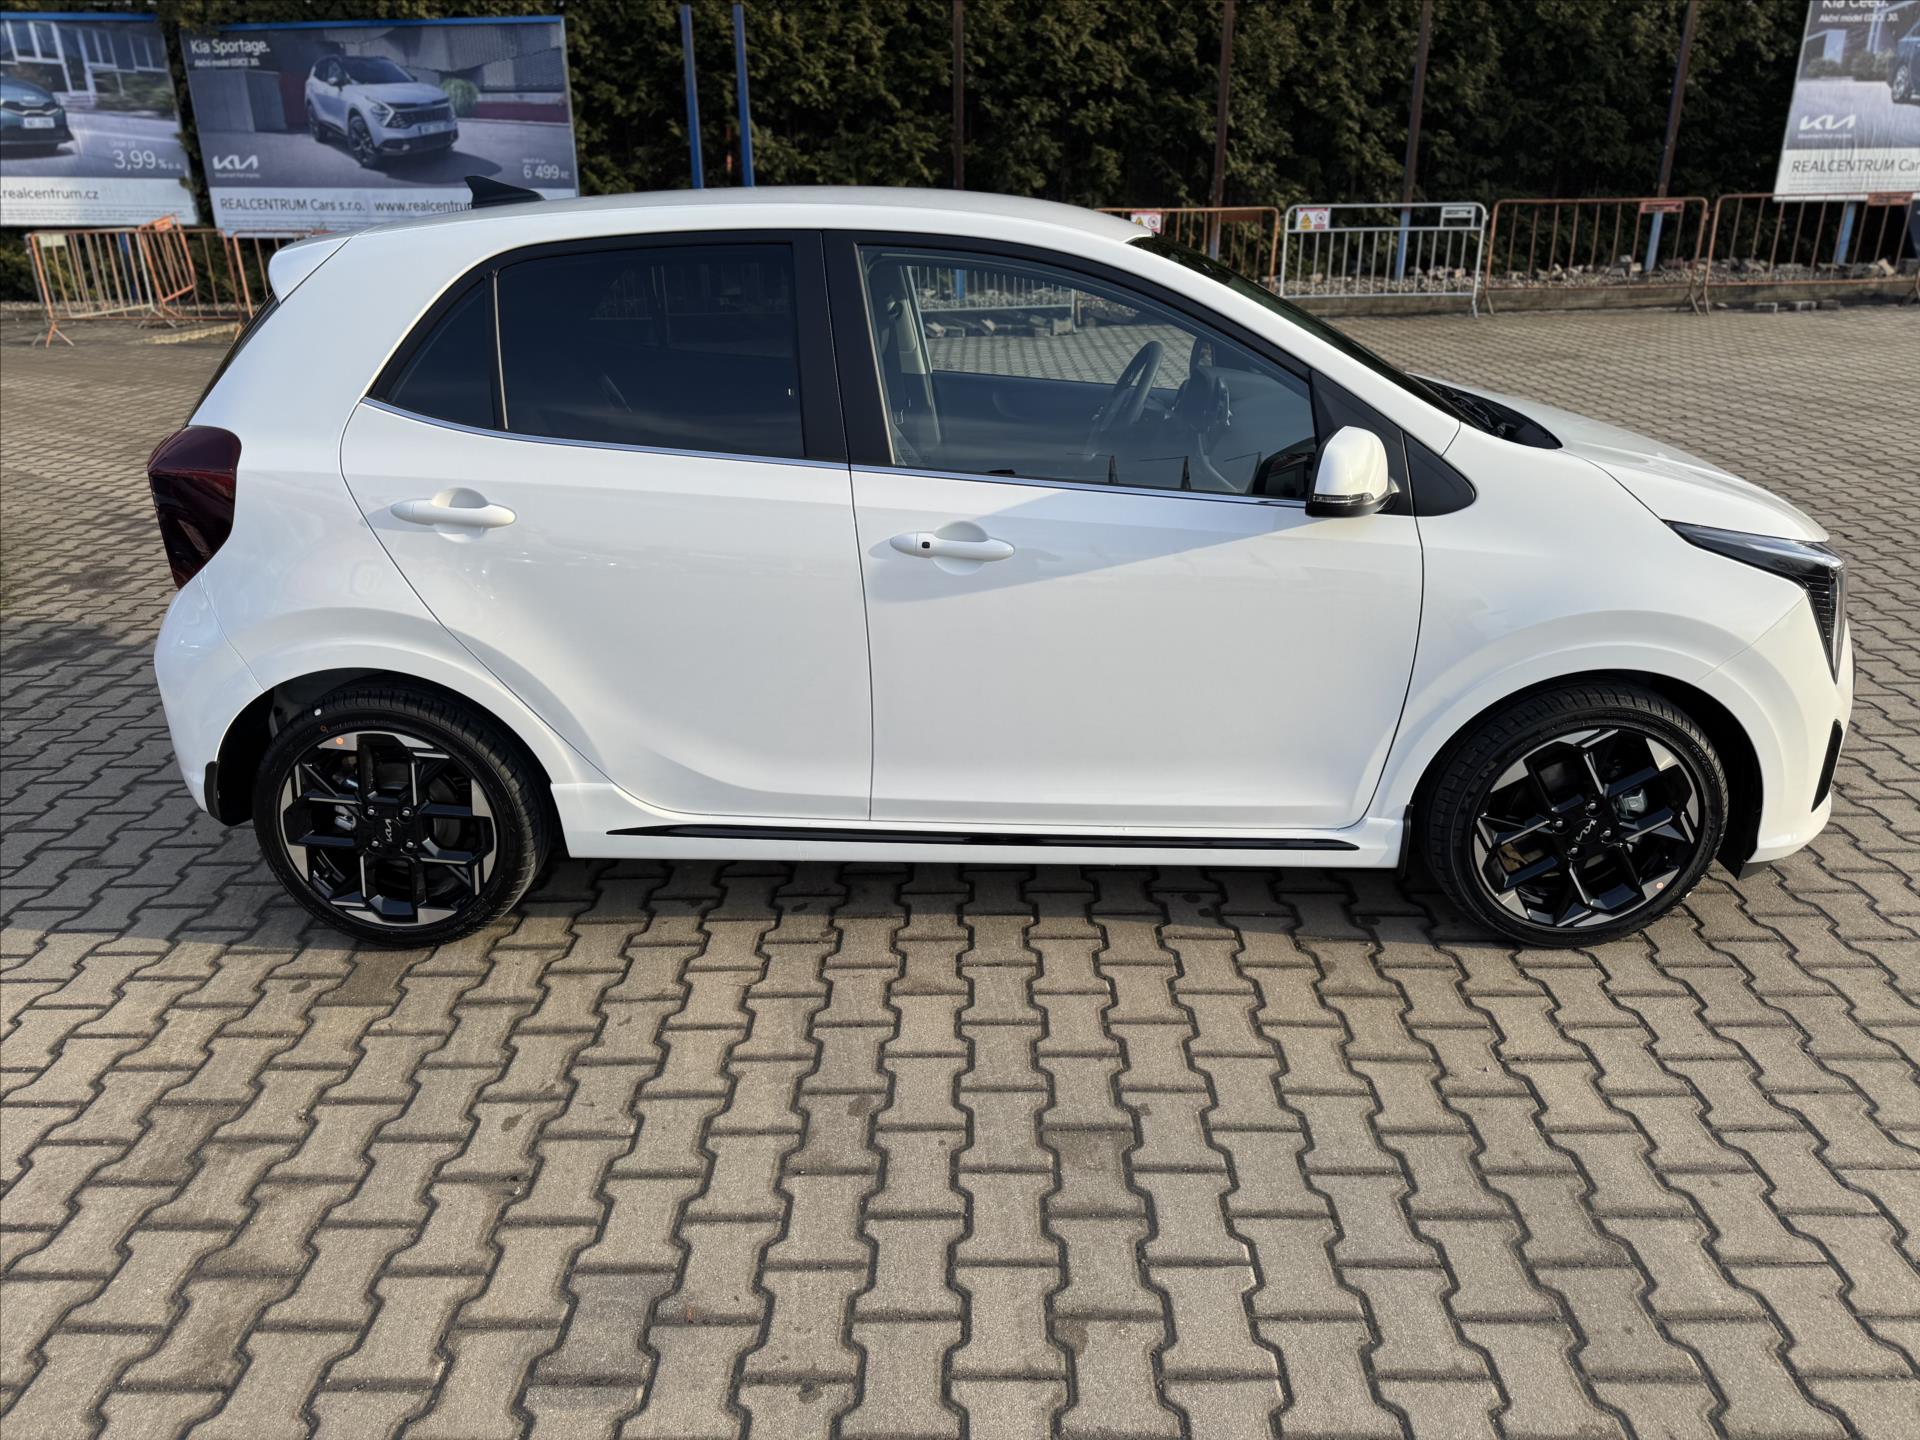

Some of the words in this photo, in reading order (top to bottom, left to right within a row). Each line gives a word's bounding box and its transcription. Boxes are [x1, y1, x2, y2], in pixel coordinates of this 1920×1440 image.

[190, 39, 210, 54] Kia
[212, 38, 271, 56] Sportage.
[1800, 114, 1856, 130] KIA
[113, 149, 156, 171] 3,99
[212, 154, 259, 170] KIA
[1791, 159, 1895, 173] REALCENTRUM
[523, 164, 533, 179] 6
[535, 164, 560, 180] 499
[220, 197, 308, 211] REALCENTRUM
[310, 198, 336, 211] Cars
[338, 201, 366, 212] s.r.o.
